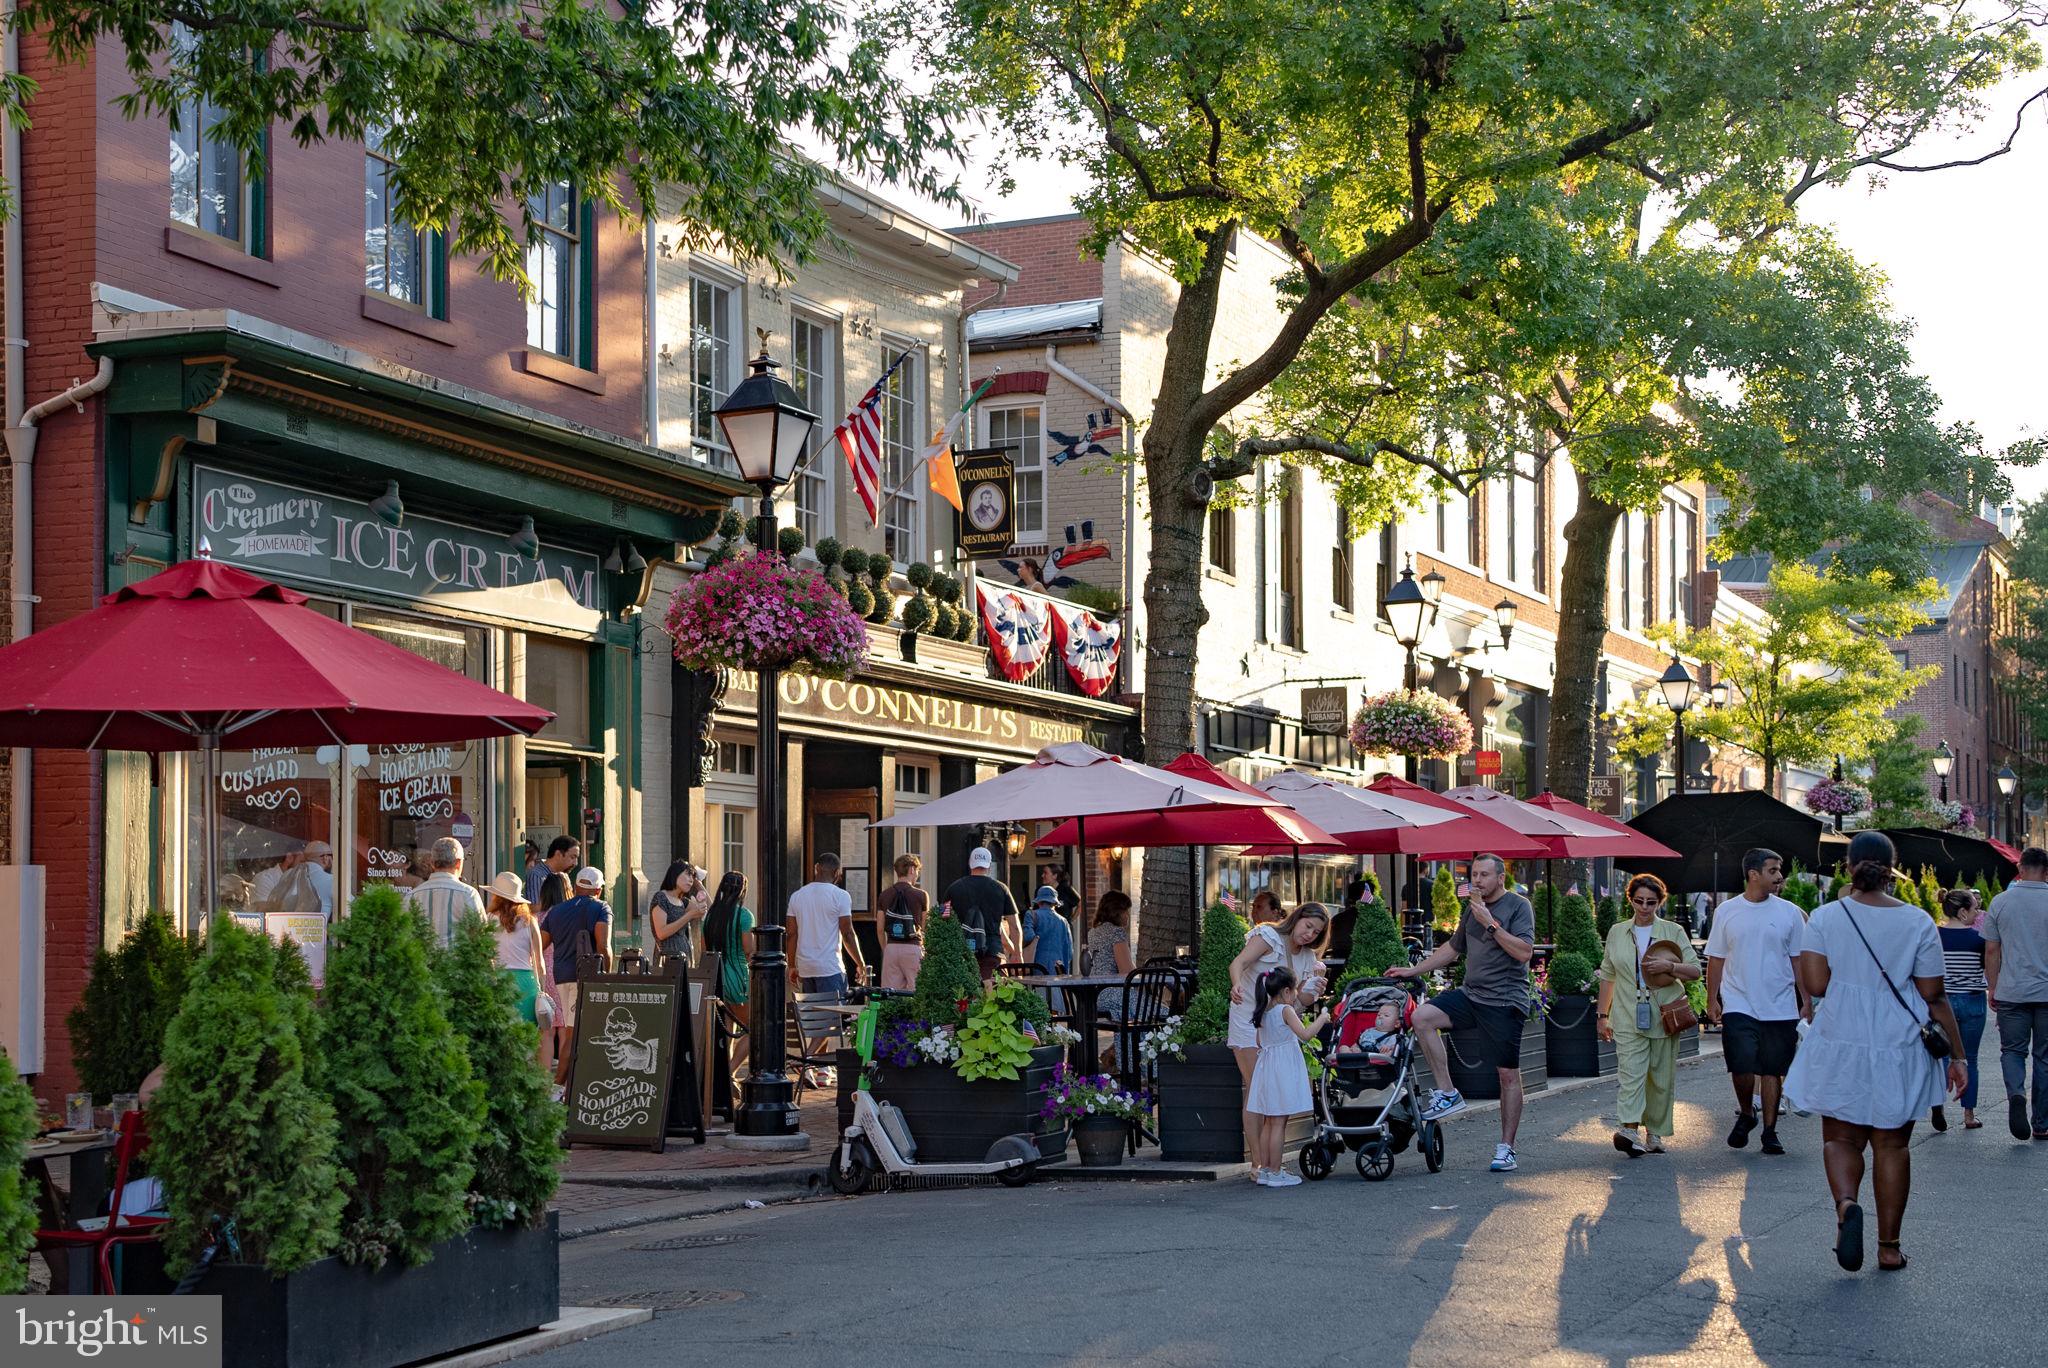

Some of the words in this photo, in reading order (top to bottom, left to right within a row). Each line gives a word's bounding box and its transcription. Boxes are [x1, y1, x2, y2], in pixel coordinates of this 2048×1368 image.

[961, 466, 1010, 481] O'CONNELL'S
[232, 487, 253, 499] The
[203, 488, 323, 533] Creamery
[248, 536, 310, 553] HOMEMADE
[963, 533, 1010, 545] RESTAURANT
[331, 515, 417, 579] ICE
[425, 538, 595, 609] CREAM
[779, 672, 1018, 739] O'CONNELL'S
[1029, 719, 1108, 749] RESTAURANT
[221, 760, 299, 793] CUSTARD
[380, 747, 452, 784] HOMEMADE
[379, 785, 401, 812] ICE
[404, 774, 452, 804] CREAM
[1591, 779, 1610, 788] PER
[367, 867, 387, 877] Since
[589, 991, 609, 1003] THE
[612, 992, 667, 1005] CREAMERY
[577, 1109, 601, 1126] ICE
[603, 1095, 651, 1123] CREAM
[578, 1080, 658, 1111] HOMEMADE
